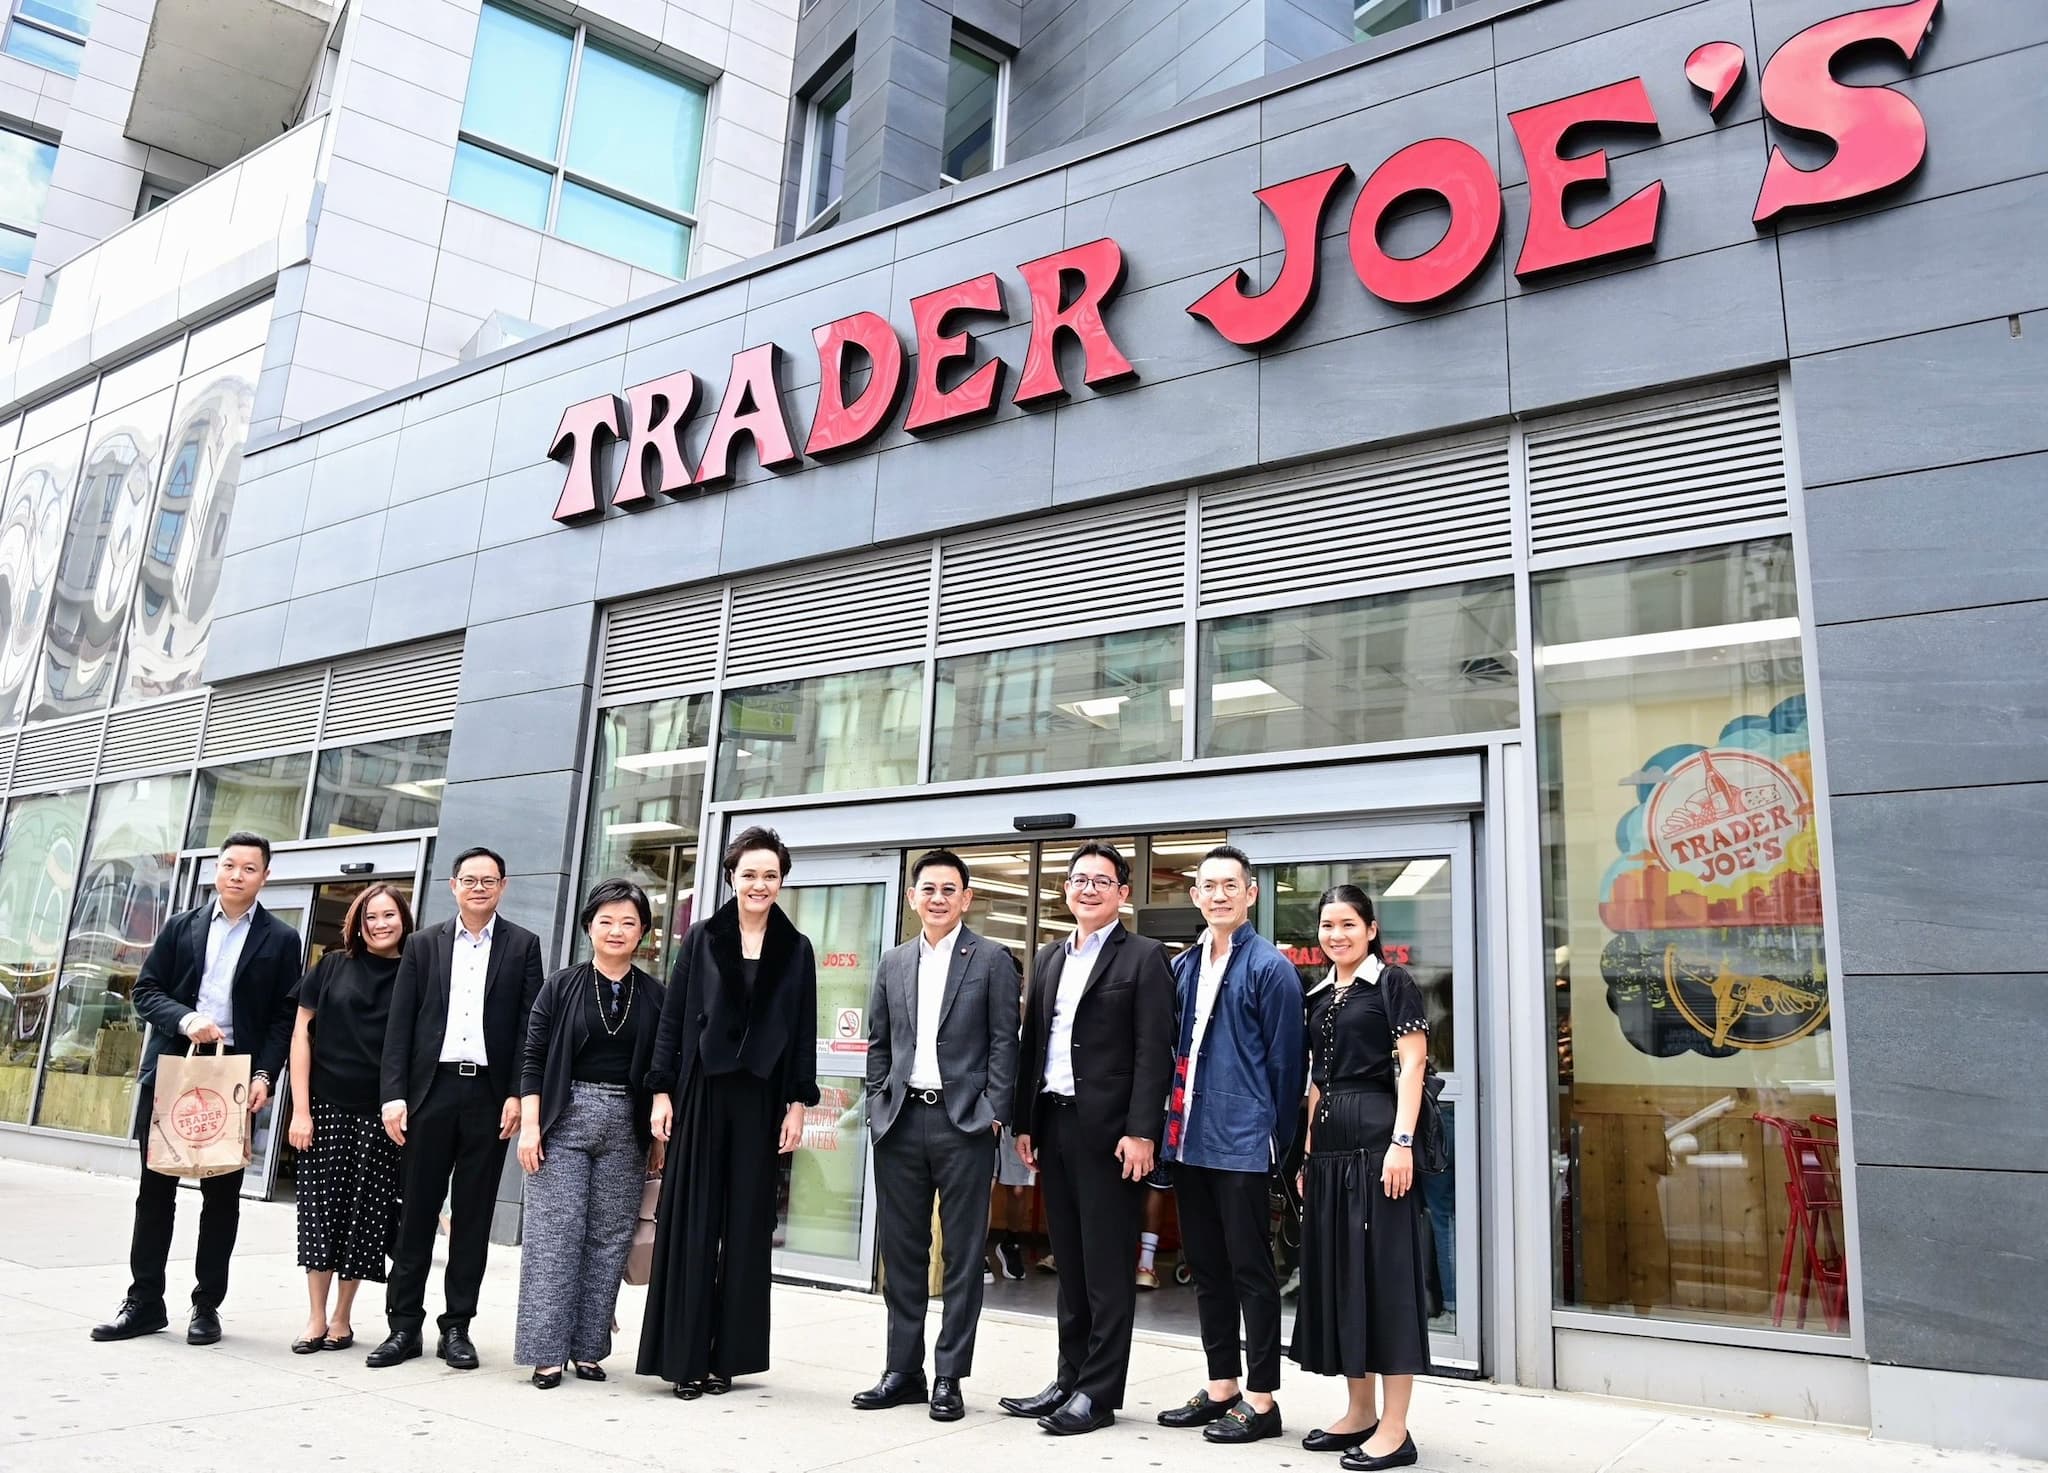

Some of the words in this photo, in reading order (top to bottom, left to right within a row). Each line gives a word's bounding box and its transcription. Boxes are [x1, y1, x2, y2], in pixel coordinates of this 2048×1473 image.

[547, 237, 1139, 523] TRADER
[1185, 0, 1943, 347] JOE'S
[1671, 804, 1793, 864] TRADER
[1698, 836, 1783, 882] JOE'S
[822, 953, 857, 968] JOE'S
[178, 1110, 222, 1128] TRADER
[186, 1120, 217, 1136] JOE'S
